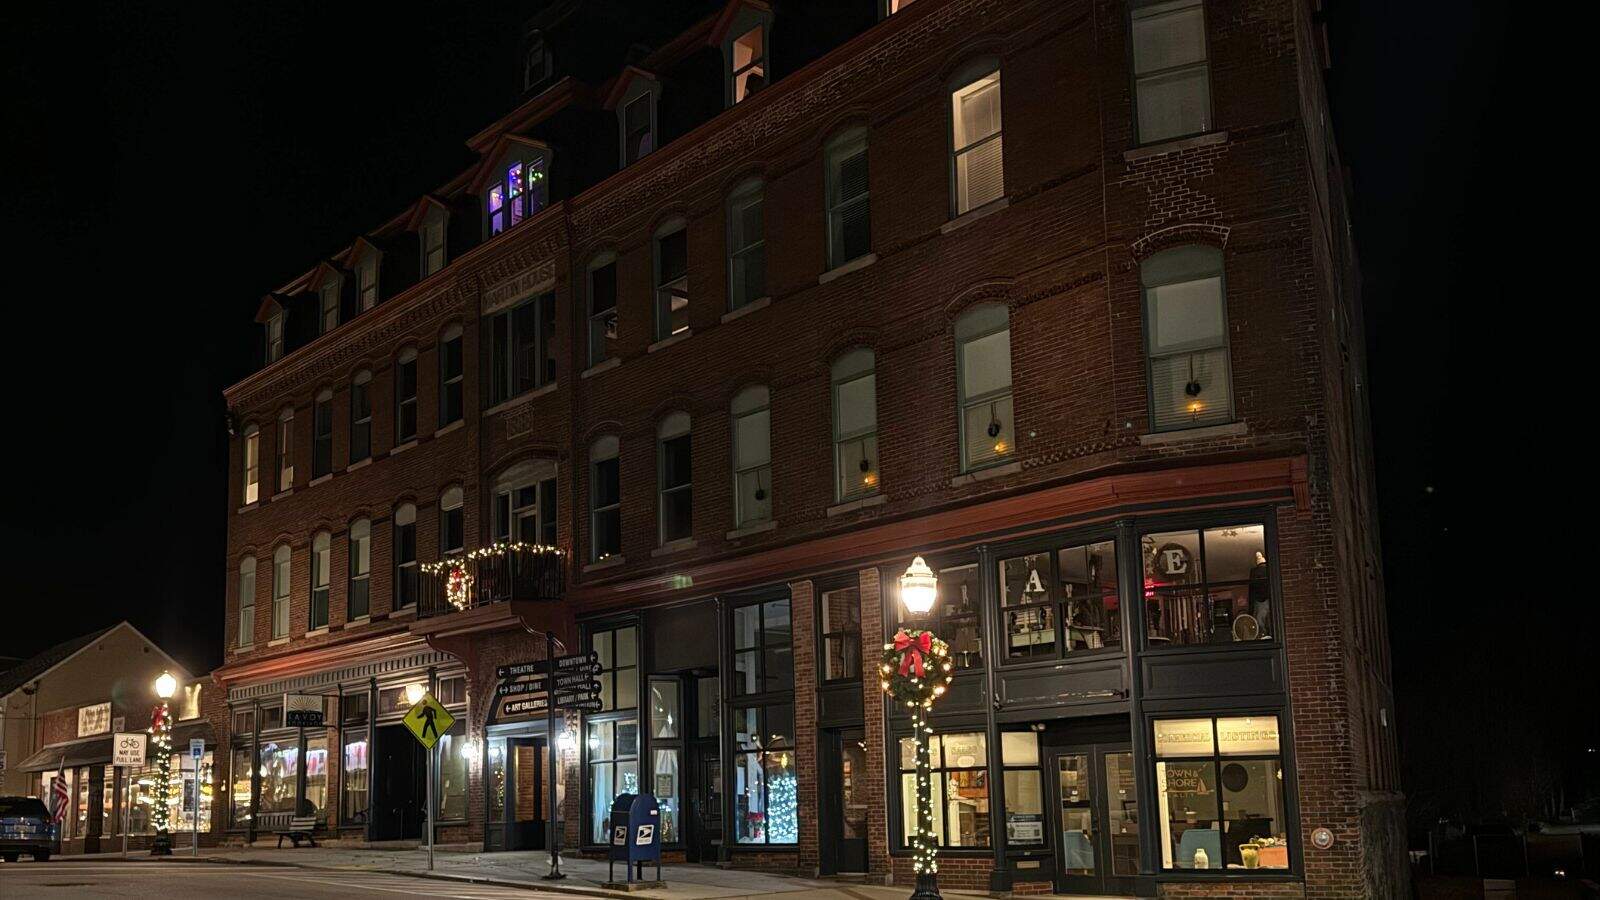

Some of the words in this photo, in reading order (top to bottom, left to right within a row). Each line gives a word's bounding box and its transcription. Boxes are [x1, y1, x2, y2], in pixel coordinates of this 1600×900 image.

[1163, 549, 1187, 575] E
[1023, 569, 1046, 593] A
[558, 656, 587, 668] DOWNTOWN
[510, 665, 535, 675] THEATRE
[557, 677, 571, 687] TOWN
[572, 674, 585, 684] HALL
[509, 684, 525, 693] SHOP
[529, 682, 542, 691] DINE
[511, 702, 521, 712] ART
[521, 699, 548, 710] GALLERIES
